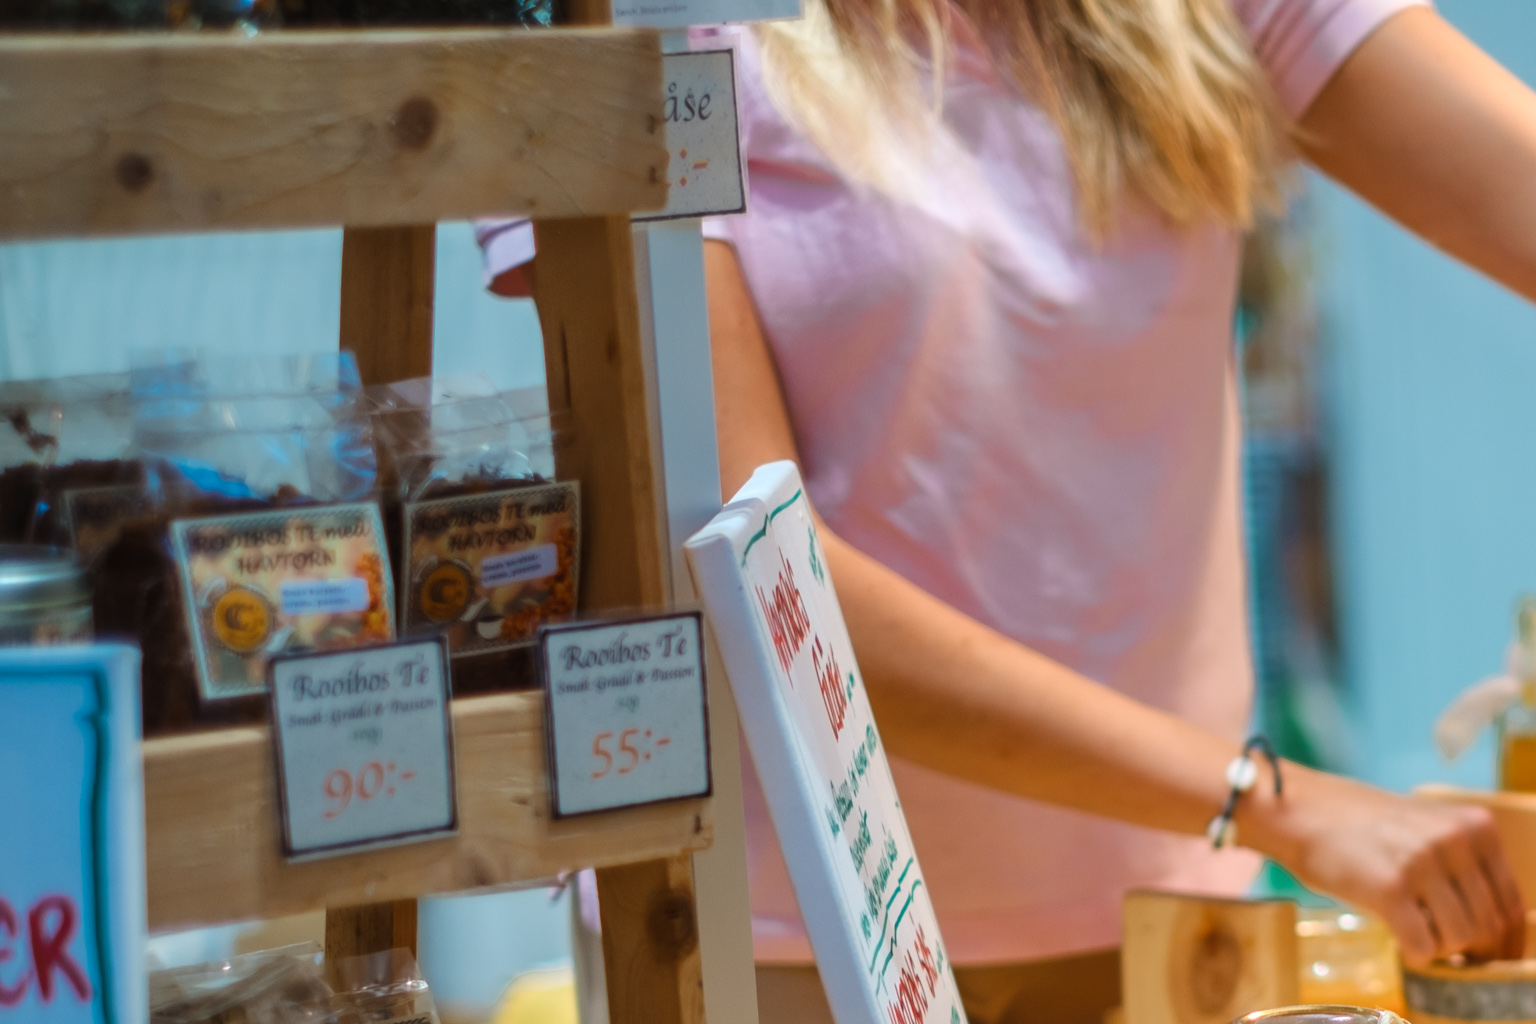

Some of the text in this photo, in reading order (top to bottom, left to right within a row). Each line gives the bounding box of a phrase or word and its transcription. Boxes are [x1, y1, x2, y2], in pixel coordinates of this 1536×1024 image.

[664, 82, 713, 122] åse
[448, 525, 537, 552] HAVTORN
[236, 550, 337, 577] HAVTORN
[560, 625, 689, 672] Rooibos Te
[291, 653, 430, 703] Rooibos Te
[590, 727, 672, 780] 55:-
[321, 760, 417, 820] 90:-
